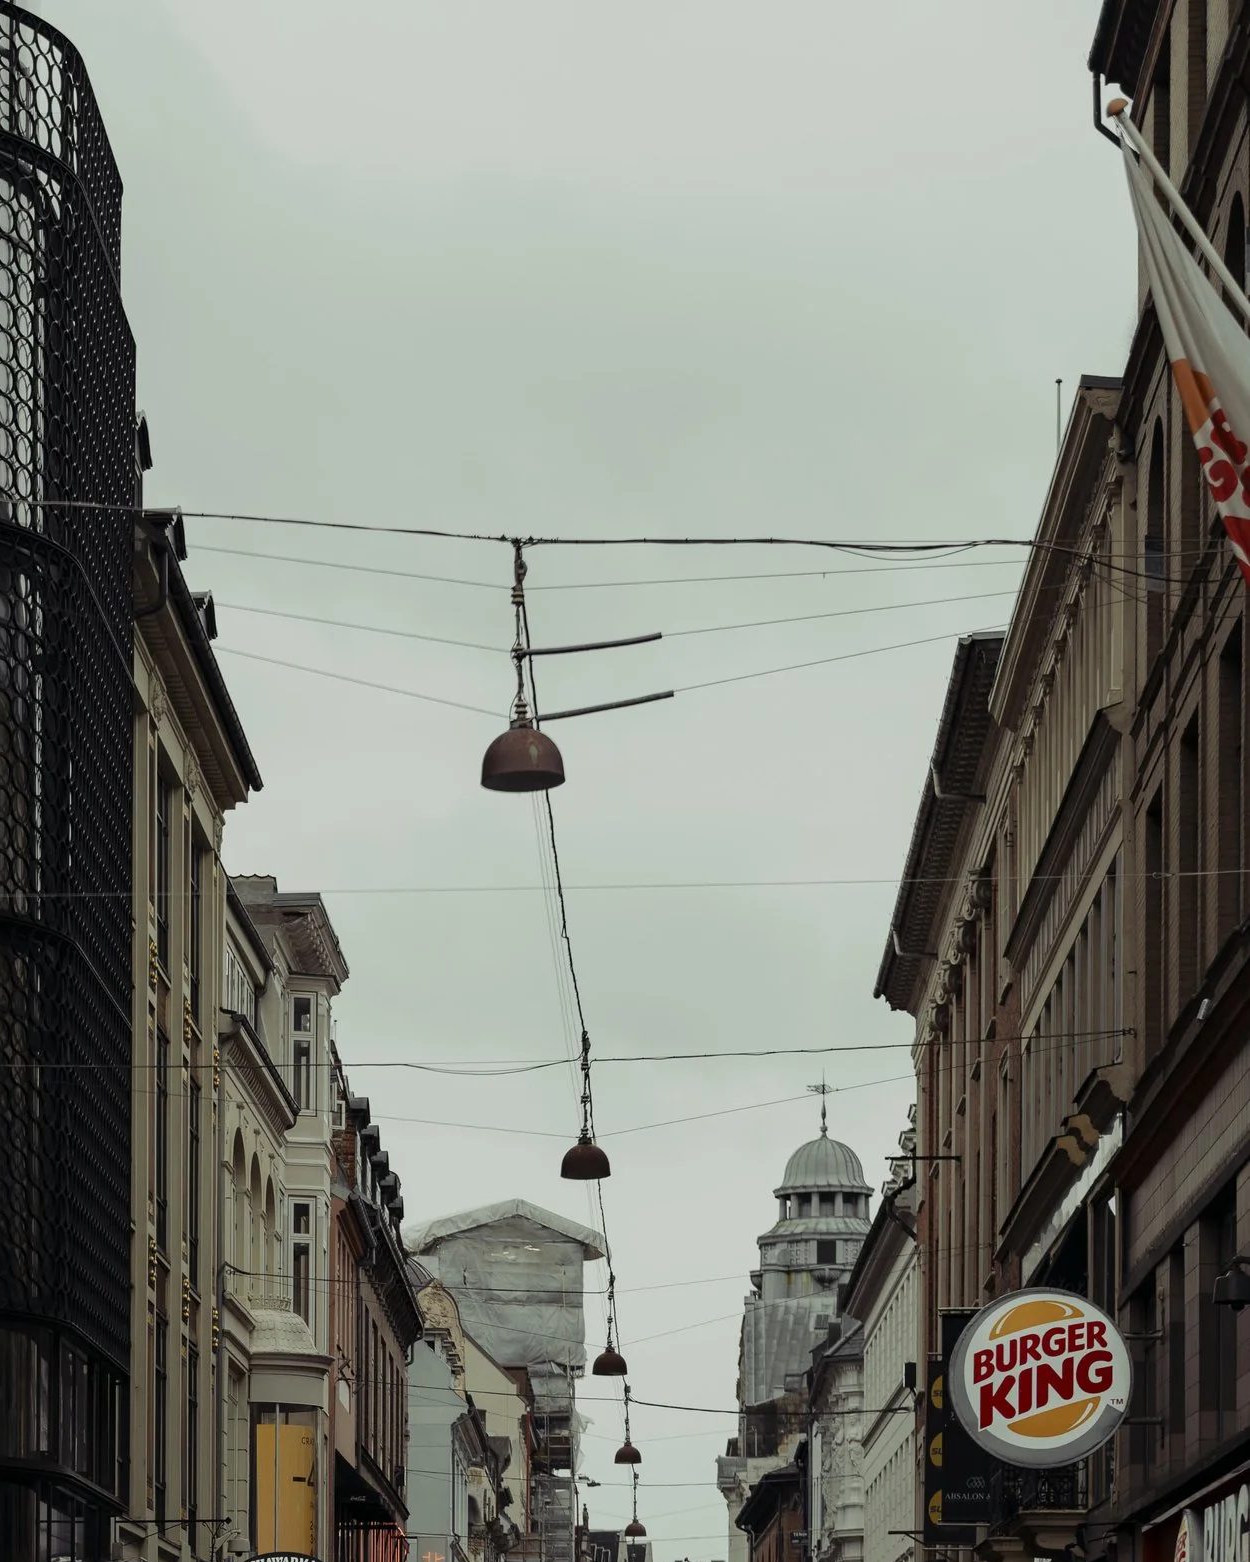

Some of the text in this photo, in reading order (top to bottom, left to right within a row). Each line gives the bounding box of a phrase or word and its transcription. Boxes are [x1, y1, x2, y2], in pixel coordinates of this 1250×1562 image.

[974, 1321, 1108, 1384] BURGER
[980, 1350, 1113, 1429] KING
[945, 1492, 985, 1500] ABSALON
